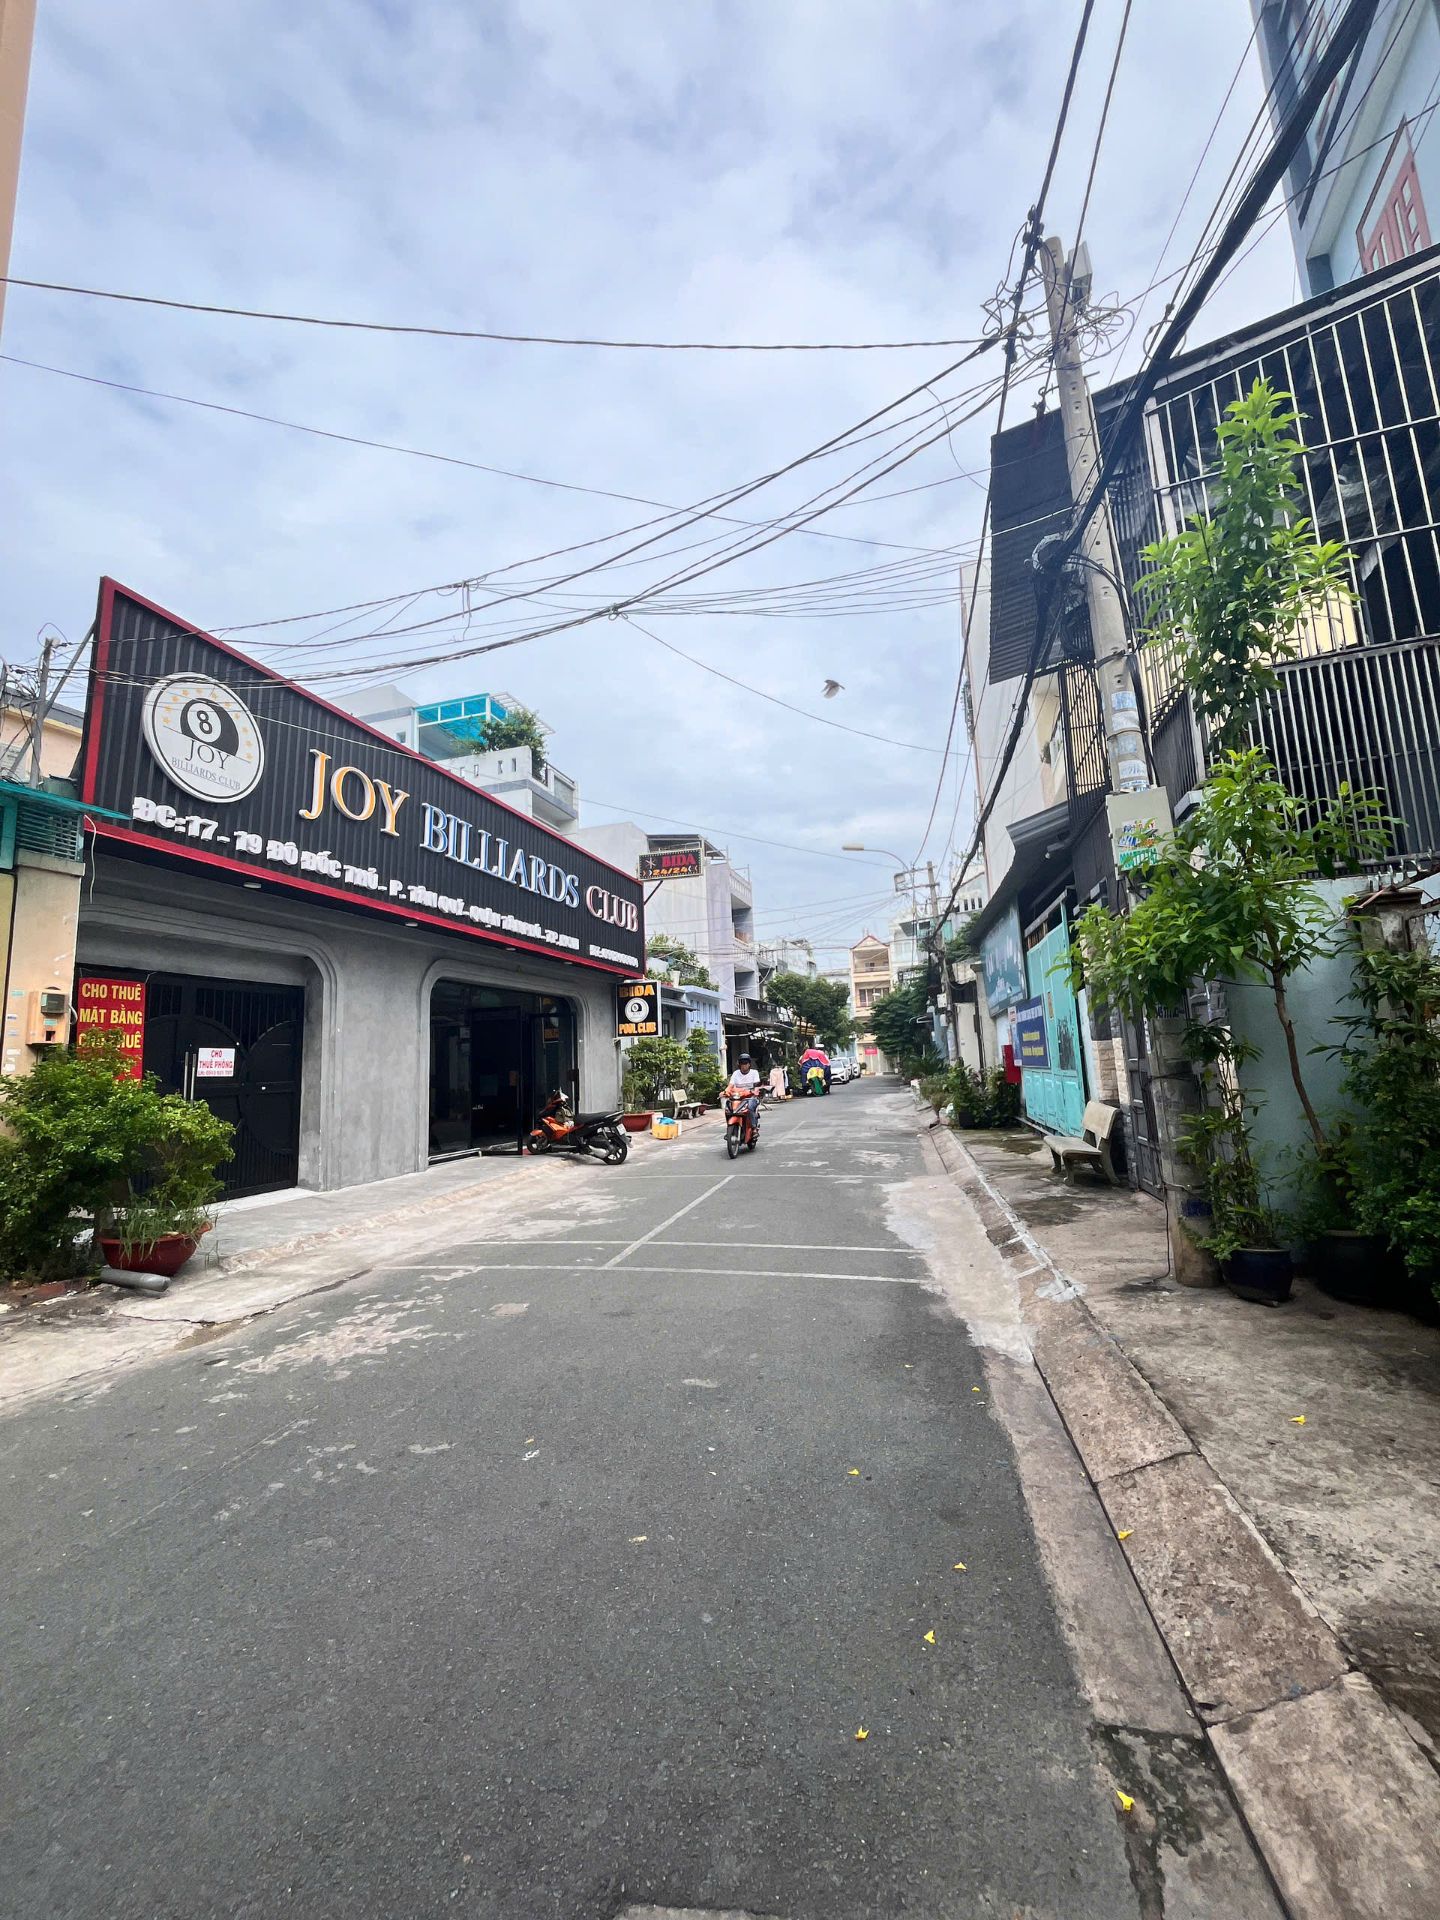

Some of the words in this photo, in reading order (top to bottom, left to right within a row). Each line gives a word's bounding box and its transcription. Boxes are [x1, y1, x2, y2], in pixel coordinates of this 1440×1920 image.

[197, 710, 213, 734] 8
[185, 740, 231, 770] JOY
[171, 757, 217, 783] BILLIARDS
[218, 775, 241, 790] CLUB
[233, 830, 263, 855] 19
[299, 749, 410, 836] JOY
[420, 803, 580, 908] BILLIARDS
[586, 885, 639, 932] CLUB
[662, 854, 696, 867] BIDA
[653, 867, 688, 876] 24/24
[82, 983, 107, 998] CHO
[112, 984, 142, 1000] THUÊ
[619, 984, 655, 997] BIDA
[80, 1006, 106, 1026] MẶT
[110, 1004, 143, 1024] BẰNG
[619, 1023, 638, 1034] POOL
[638, 1022, 656, 1033] CLUB
[211, 1050, 222, 1058] CHO
